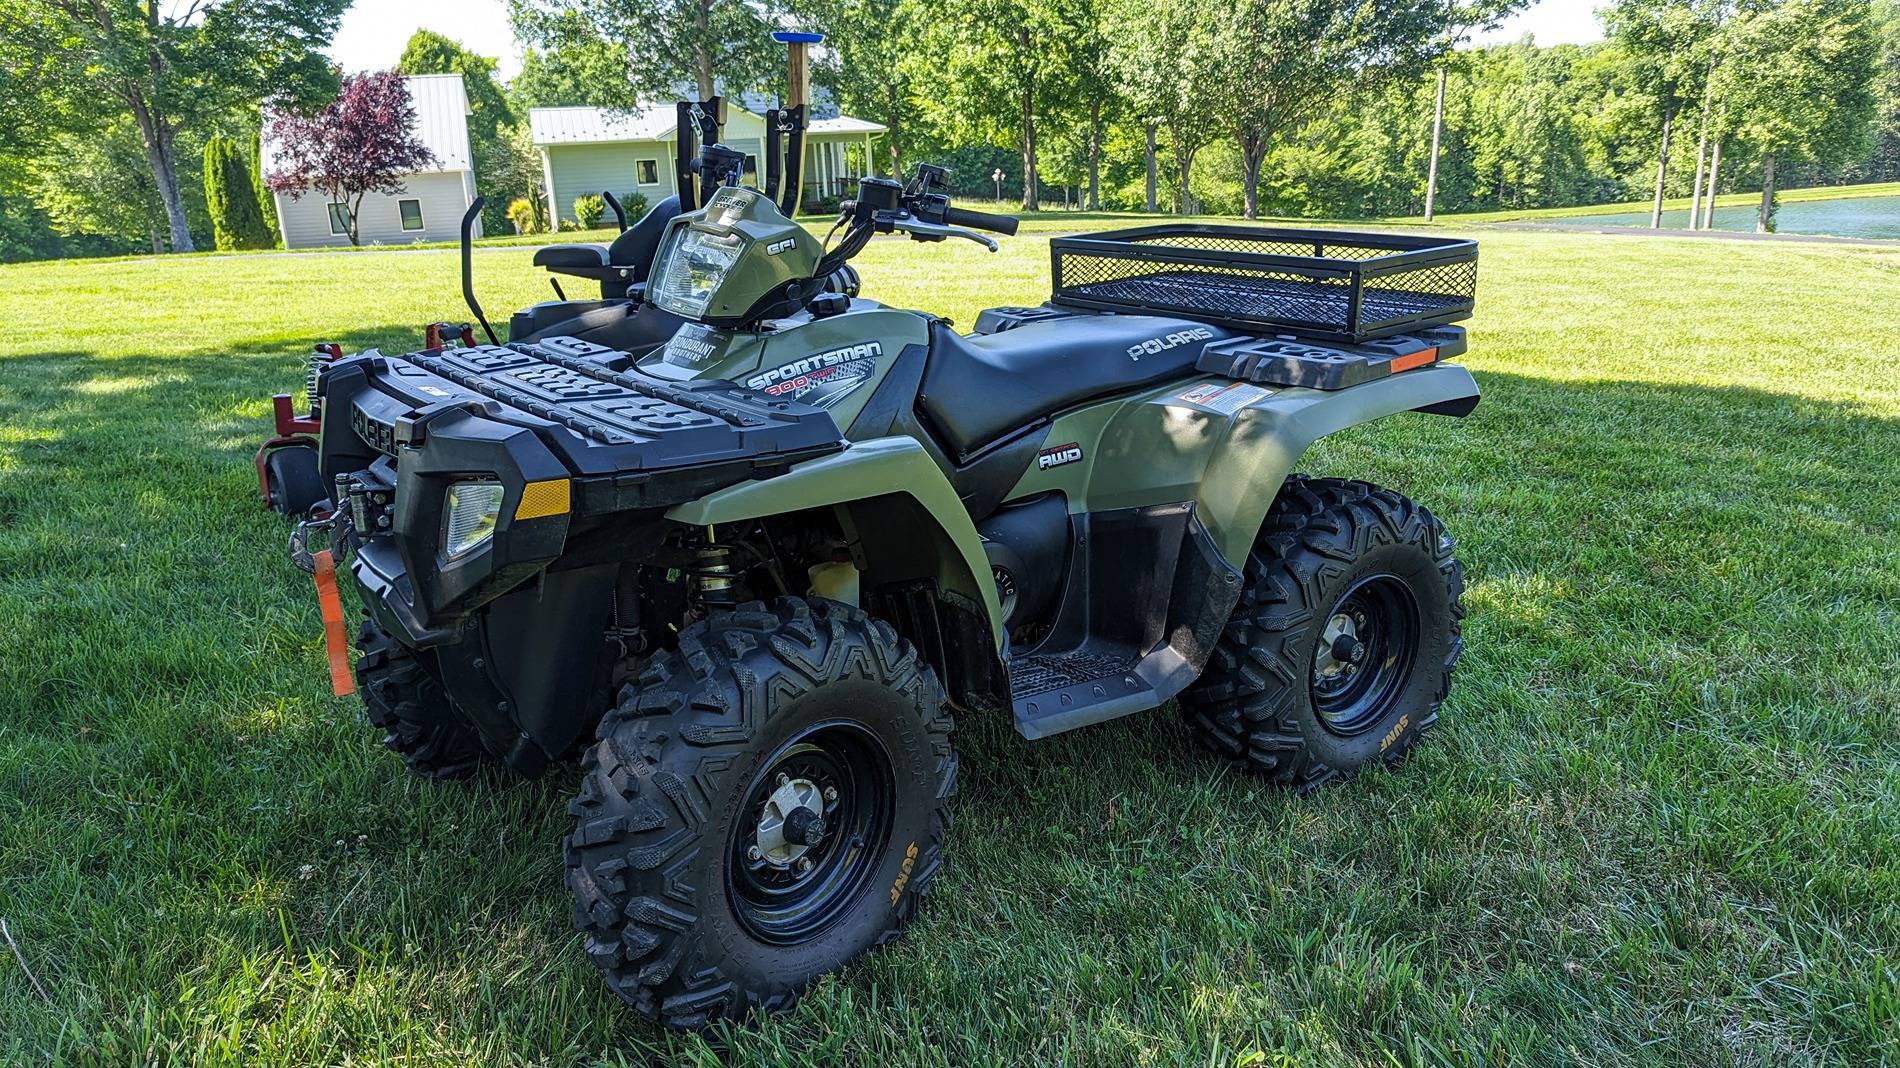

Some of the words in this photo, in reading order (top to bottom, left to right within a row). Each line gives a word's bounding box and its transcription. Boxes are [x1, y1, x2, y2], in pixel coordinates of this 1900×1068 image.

[767, 238, 796, 255] EFI
[1127, 328, 1214, 361] POLARIS
[747, 342, 882, 391] SPORTSMAN
[1039, 448, 1082, 469] AWD
[1379, 713, 1409, 753] SUNF
[890, 841, 919, 908] SUNF
